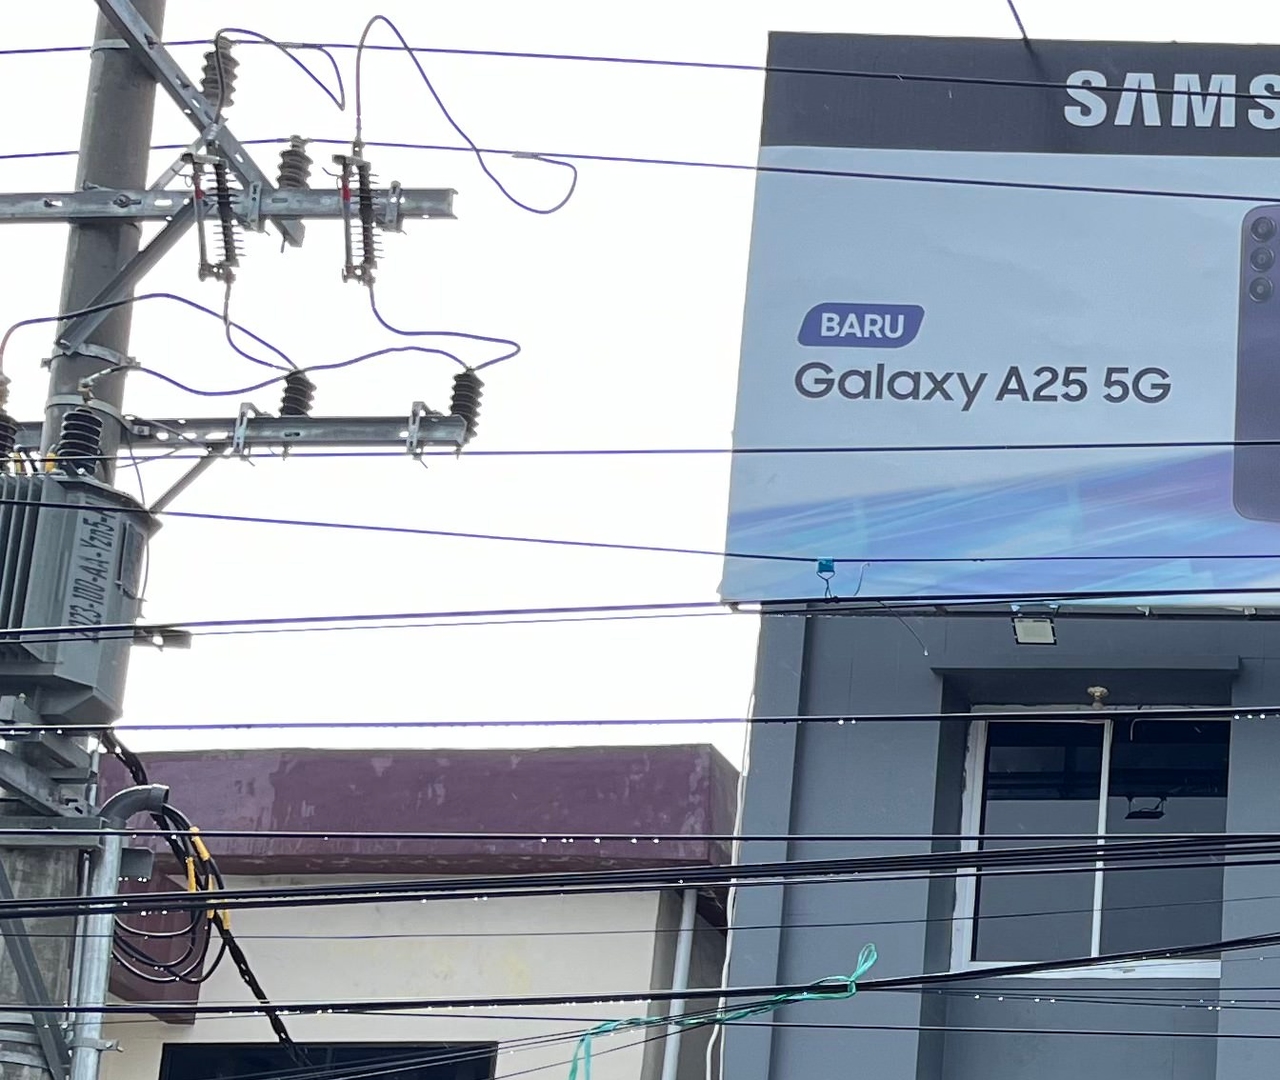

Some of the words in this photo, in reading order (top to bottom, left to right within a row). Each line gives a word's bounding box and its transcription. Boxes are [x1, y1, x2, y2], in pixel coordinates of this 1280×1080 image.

[819, 313, 905, 340] BARU
[794, 362, 987, 411] Galaxy
[995, 366, 1089, 403] A25
[1102, 367, 1172, 405] 5G
